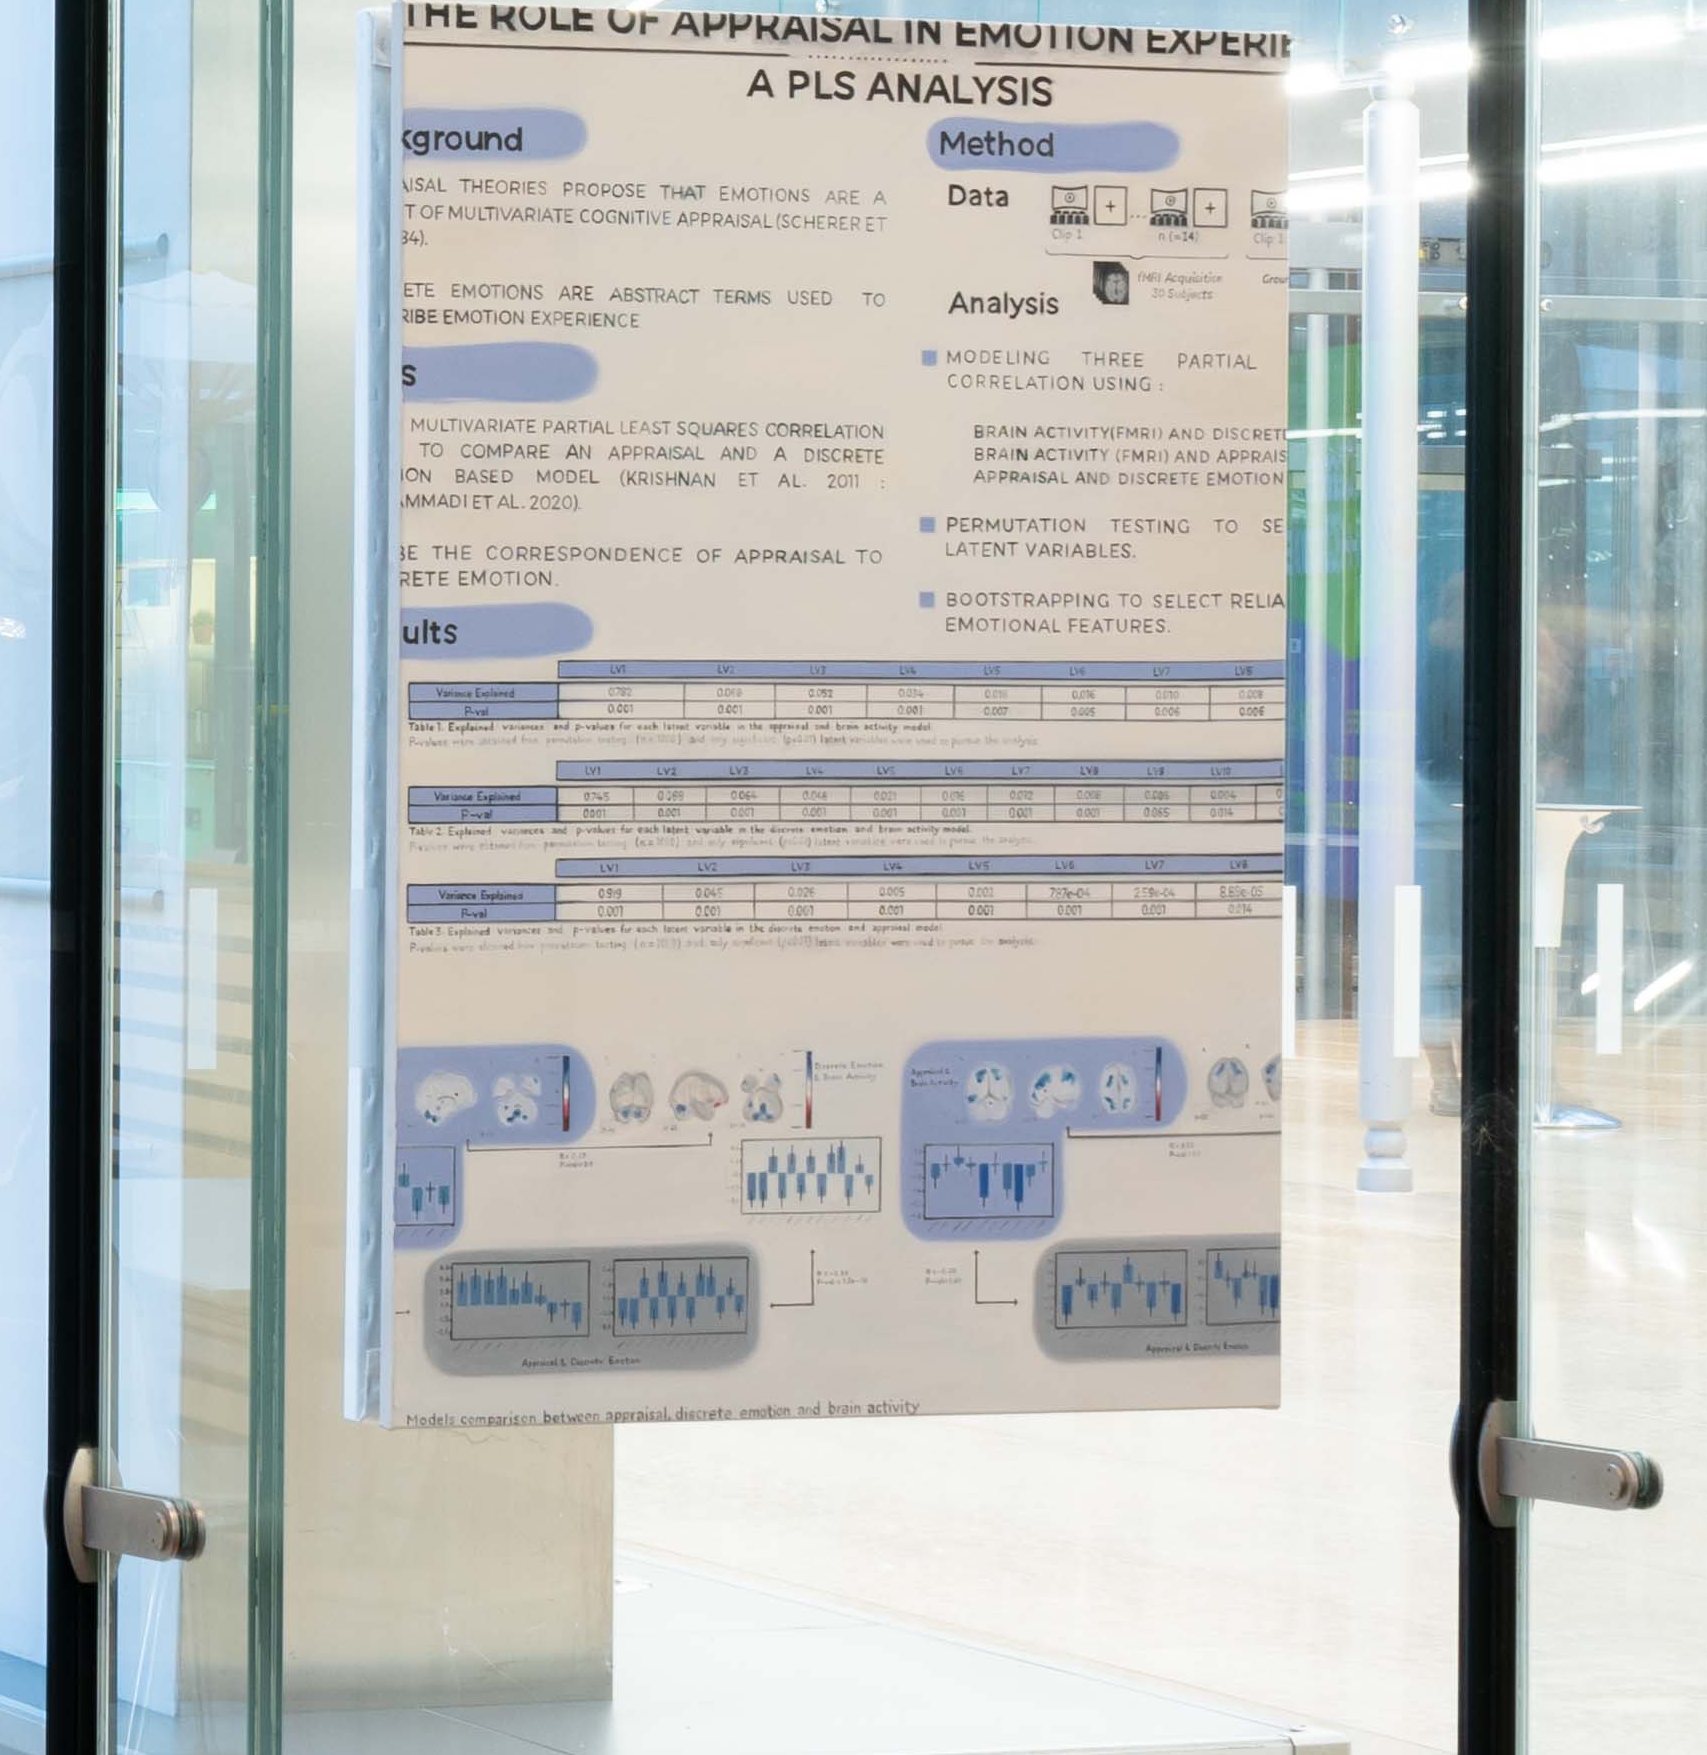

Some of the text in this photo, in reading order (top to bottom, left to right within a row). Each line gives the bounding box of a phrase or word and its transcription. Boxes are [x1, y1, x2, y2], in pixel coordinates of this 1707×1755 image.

[746, 68, 1053, 107] A PLS ANALYSIS
[940, 130, 1054, 158] Method
[458, 178, 887, 206] THEORIES PROPOSE THAT EMOTIONS ARE A
[948, 183, 1009, 208] Data
[947, 291, 1059, 320] Analysis
[947, 373, 1151, 392] CORRELATION USING
[542, 419, 884, 439] PARTIAL LEAST SQUARES CORRELATION
[431, 544, 883, 565] THE CORRESPONDENCE OF APPRAISAL TO
[945, 541, 1019, 558] LATENT
[945, 616, 1061, 634] EMOTIONAL
[406, 1400, 920, 1427] Models comparison between appraisal, discrete emotion and brain activity
